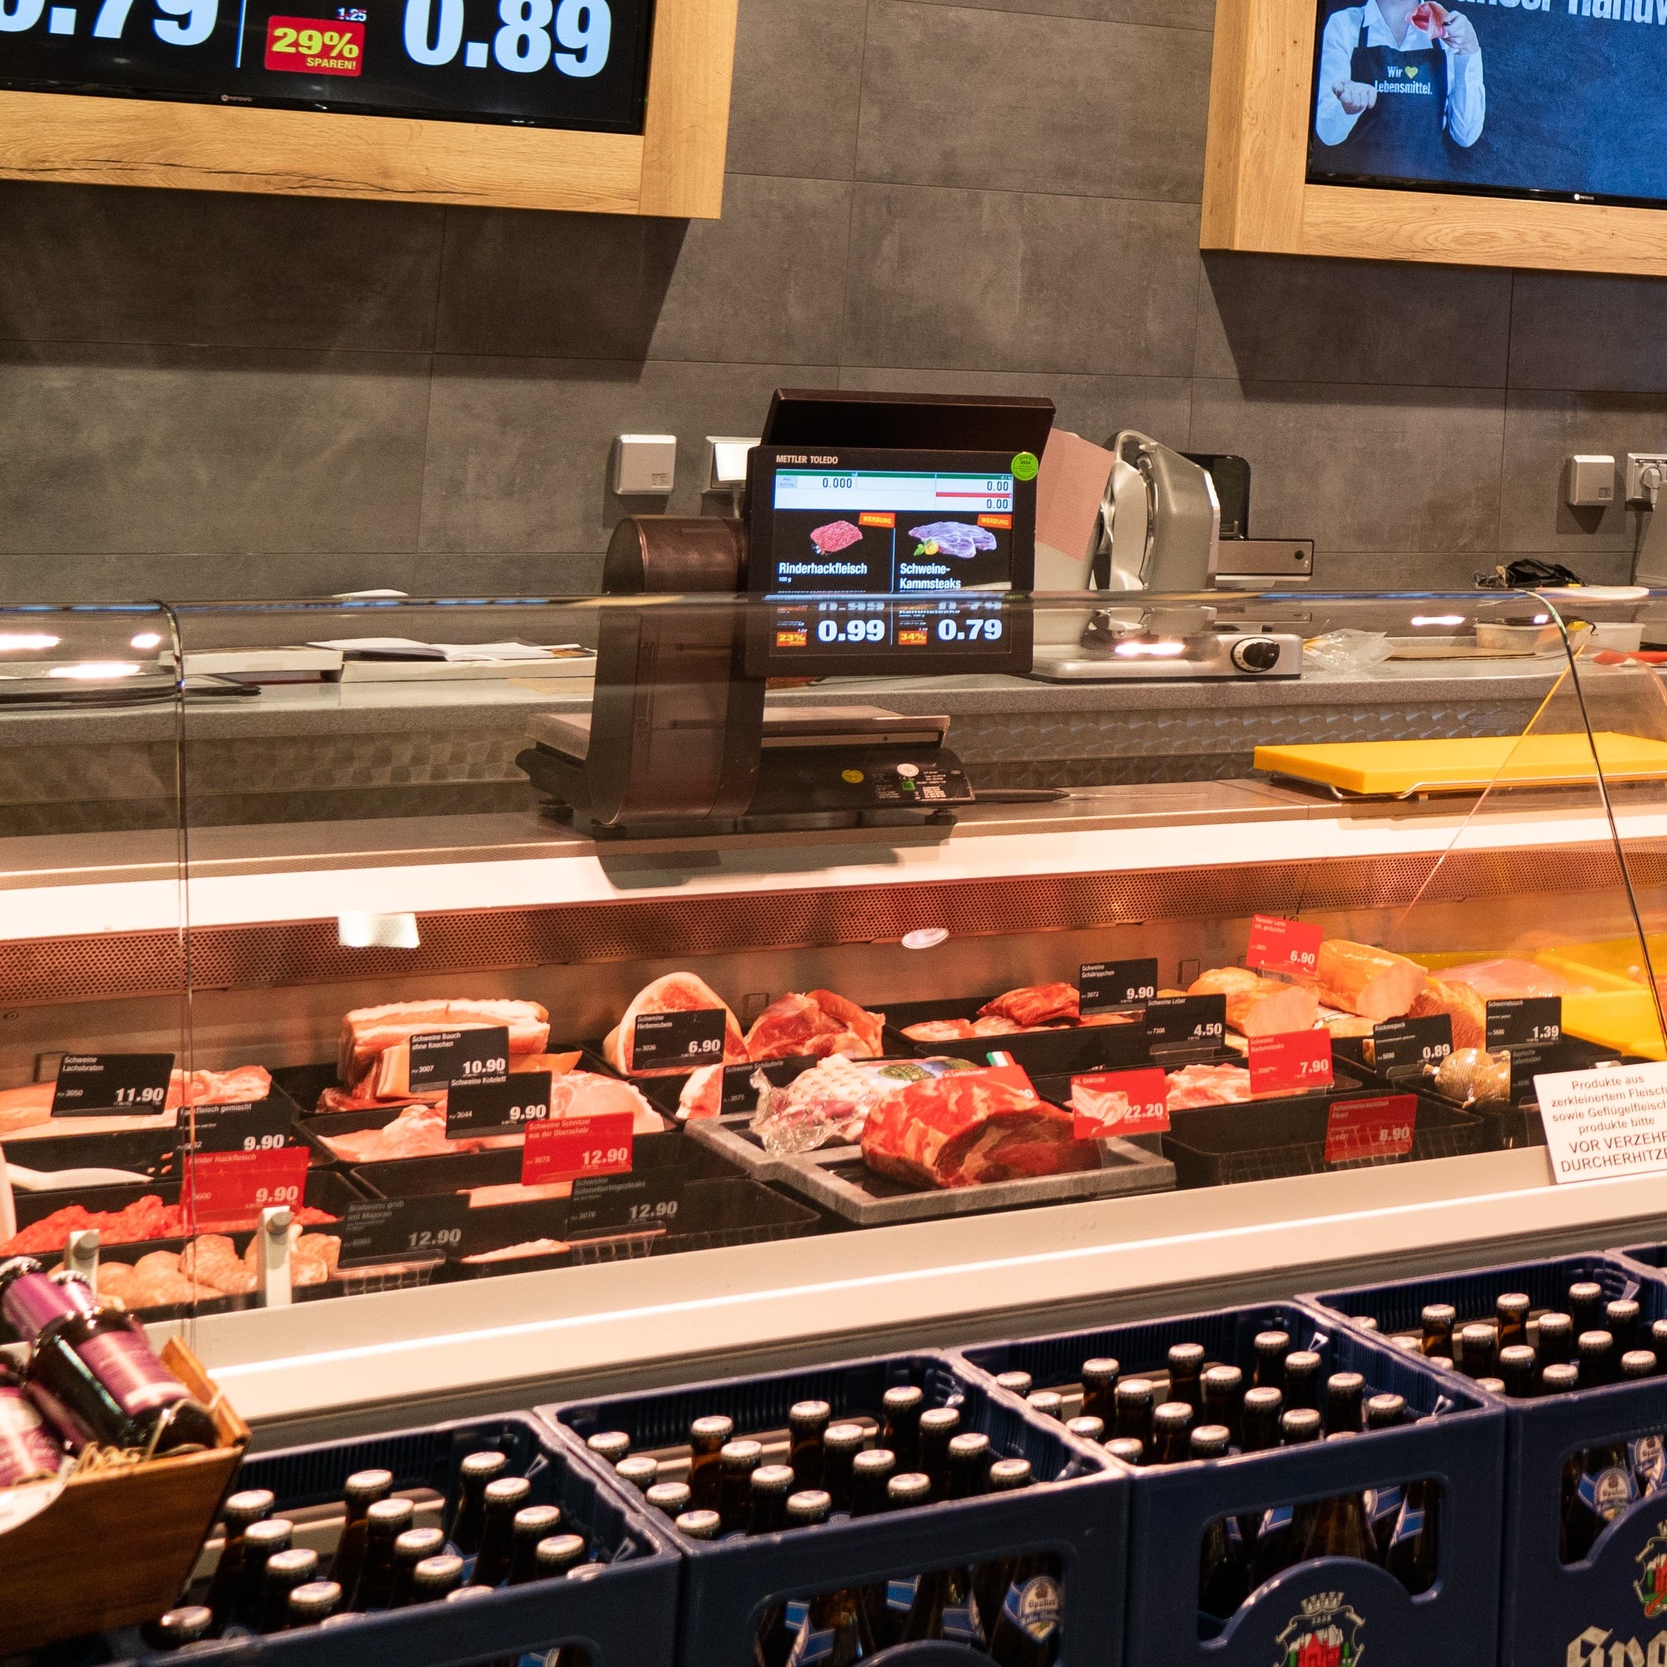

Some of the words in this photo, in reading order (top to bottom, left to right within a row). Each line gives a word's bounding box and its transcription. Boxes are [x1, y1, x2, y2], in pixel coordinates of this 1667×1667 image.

[271, 27, 360, 58] 29%
[306, 57, 357, 70] SPAREN!
[1387, 65, 1404, 78] Wir
[776, 454, 807, 464] METTLER
[810, 455, 838, 464] TOLEDO
[822, 477, 853, 489] 0.000
[986, 480, 1009, 491] 0.00
[986, 498, 1009, 509] 0.00
[862, 515, 893, 525] WERBUNG
[980, 517, 1010, 526] WERBUNG
[778, 562, 868, 575] Rinderhackfleisch
[899, 563, 951, 575] Schweine-
[899, 578, 962, 589] Kammsteaks
[777, 633, 806, 643] 23%
[899, 632, 927, 642] 34%
[817, 619, 885, 642] 0.99
[937, 619, 1003, 641] 0.79
[1290, 949, 1316, 965] 6.90
[1126, 986, 1155, 1000] 9.90
[1193, 1022, 1223, 1037] 4.50
[1532, 1025, 1560, 1040] 1.39
[429, 1040, 454, 1049] Knochen
[688, 1039, 721, 1053] 6.90
[1422, 1043, 1451, 1059] 0.89
[64, 1055, 98, 1064] Schweine
[462, 1057, 507, 1075] 10.90
[1300, 1058, 1329, 1074] 7.90
[62, 1064, 104, 1072] Lachsbraten
[451, 1078, 481, 1087] Schweine
[1571, 1077, 1622, 1090] Produkte
[1625, 1075, 1645, 1085] aus
[114, 1086, 165, 1102] 11.90
[1551, 1093, 1626, 1108] zerkleinertem
[220, 1103, 252, 1114] gemischt
[509, 1103, 547, 1121] 9.90
[1124, 1102, 1164, 1120] 22.20
[1552, 1109, 1585, 1122] sowie
[1578, 1118, 1628, 1136] produkte
[1631, 1116, 1656, 1128] bitte
[243, 1134, 285, 1151] 9.90
[1568, 1139, 1601, 1154] VOR
[582, 1147, 629, 1166] 12.90
[255, 1185, 299, 1204] 9.90
[629, 1200, 678, 1219] 12.90
[408, 1228, 462, 1246] 12.90
